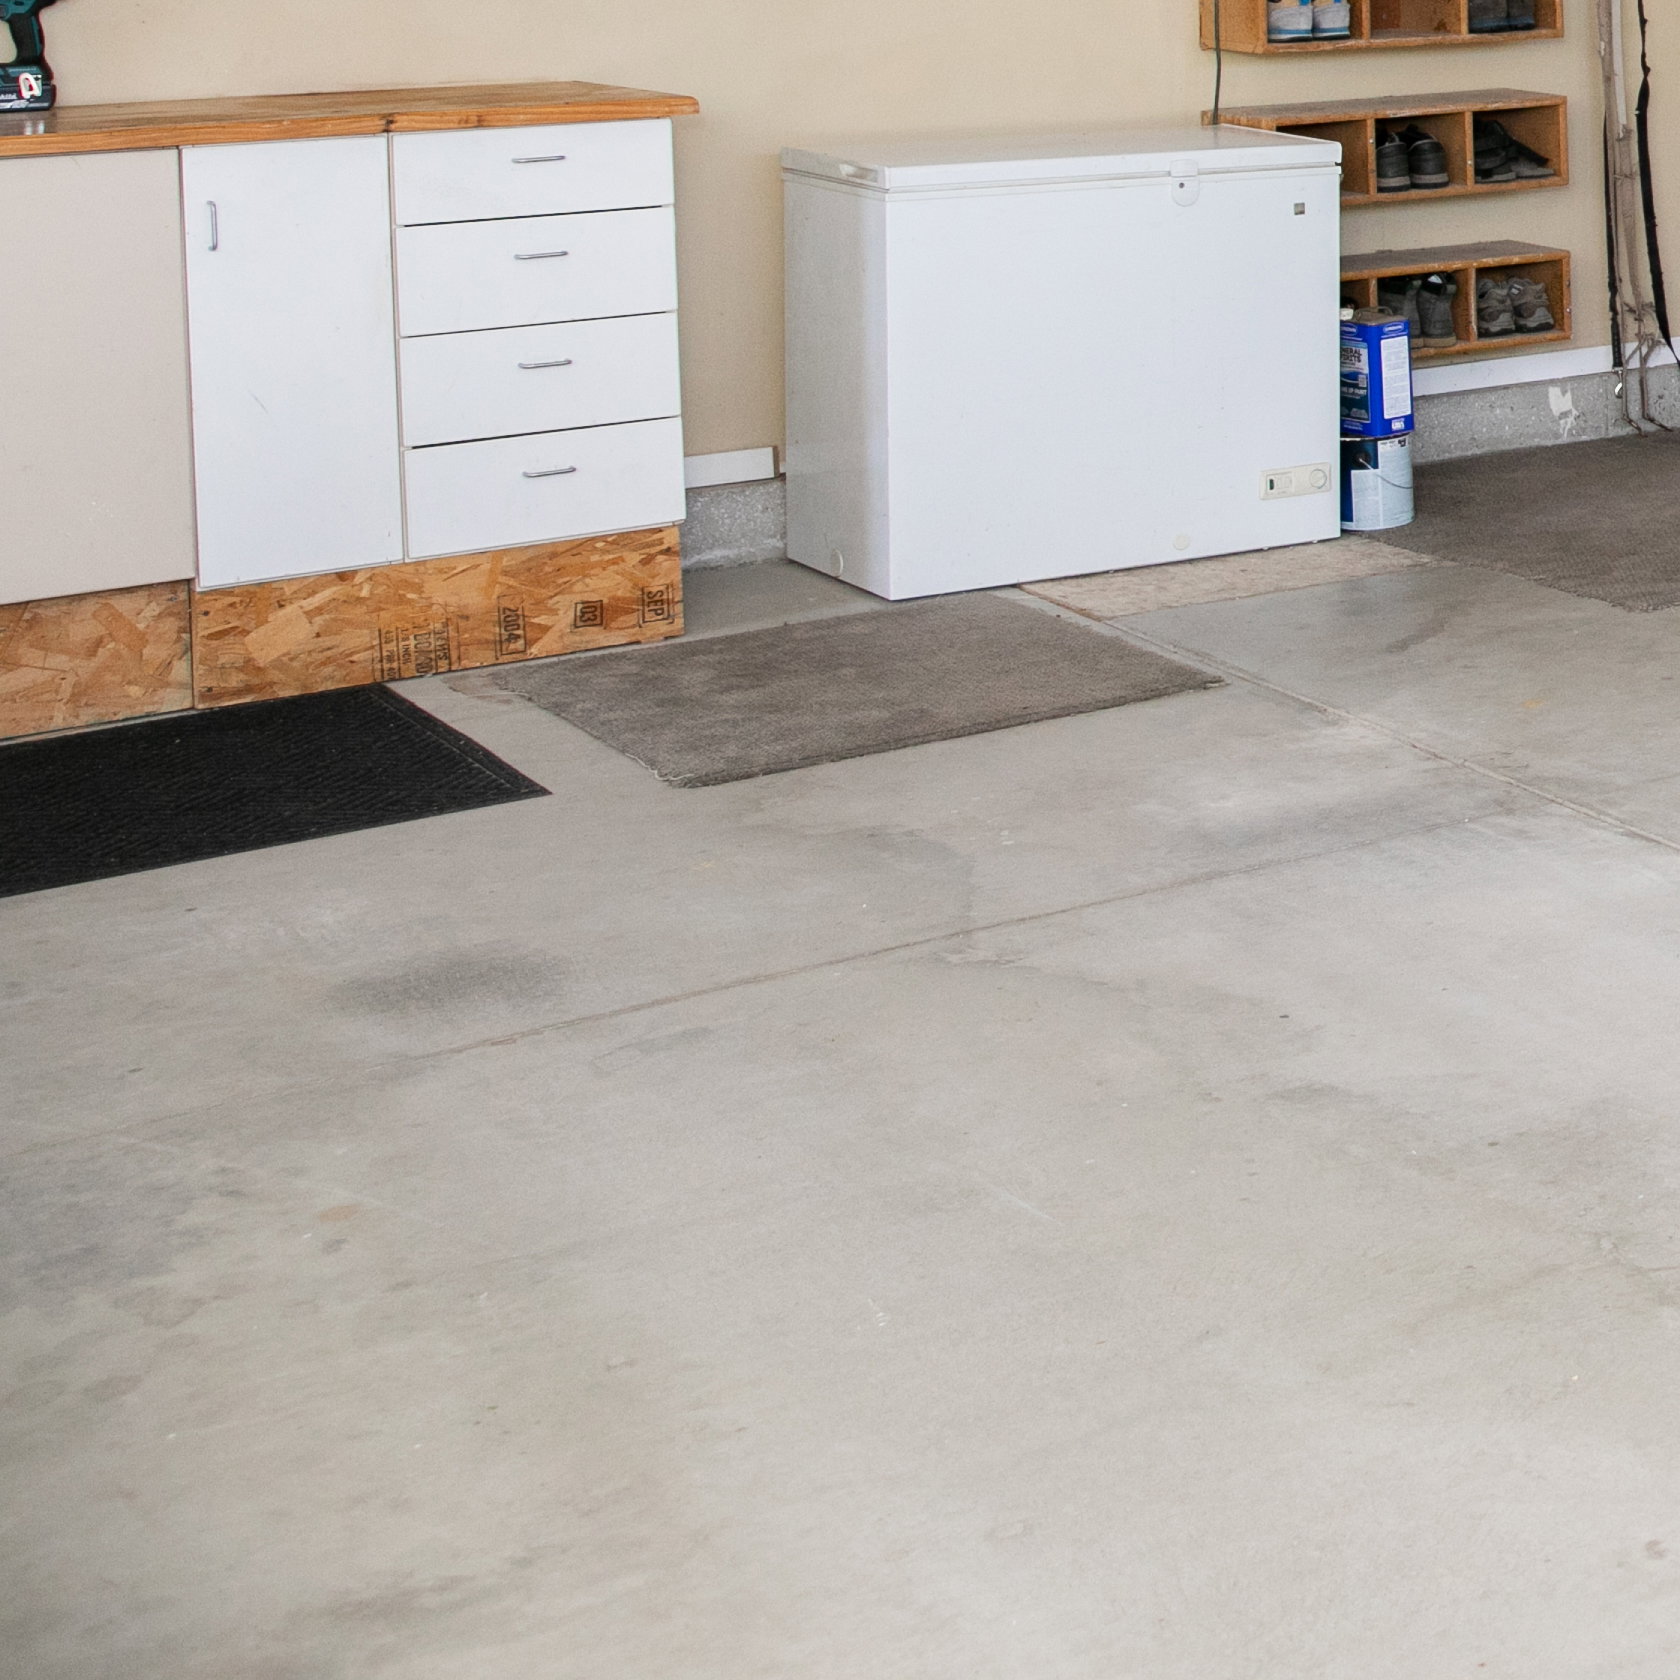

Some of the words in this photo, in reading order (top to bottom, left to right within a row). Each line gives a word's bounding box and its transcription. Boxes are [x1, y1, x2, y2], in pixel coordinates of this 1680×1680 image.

[647, 590, 664, 617] SEP
[502, 607, 521, 649] 2004
[402, 644, 412, 664] INCH
